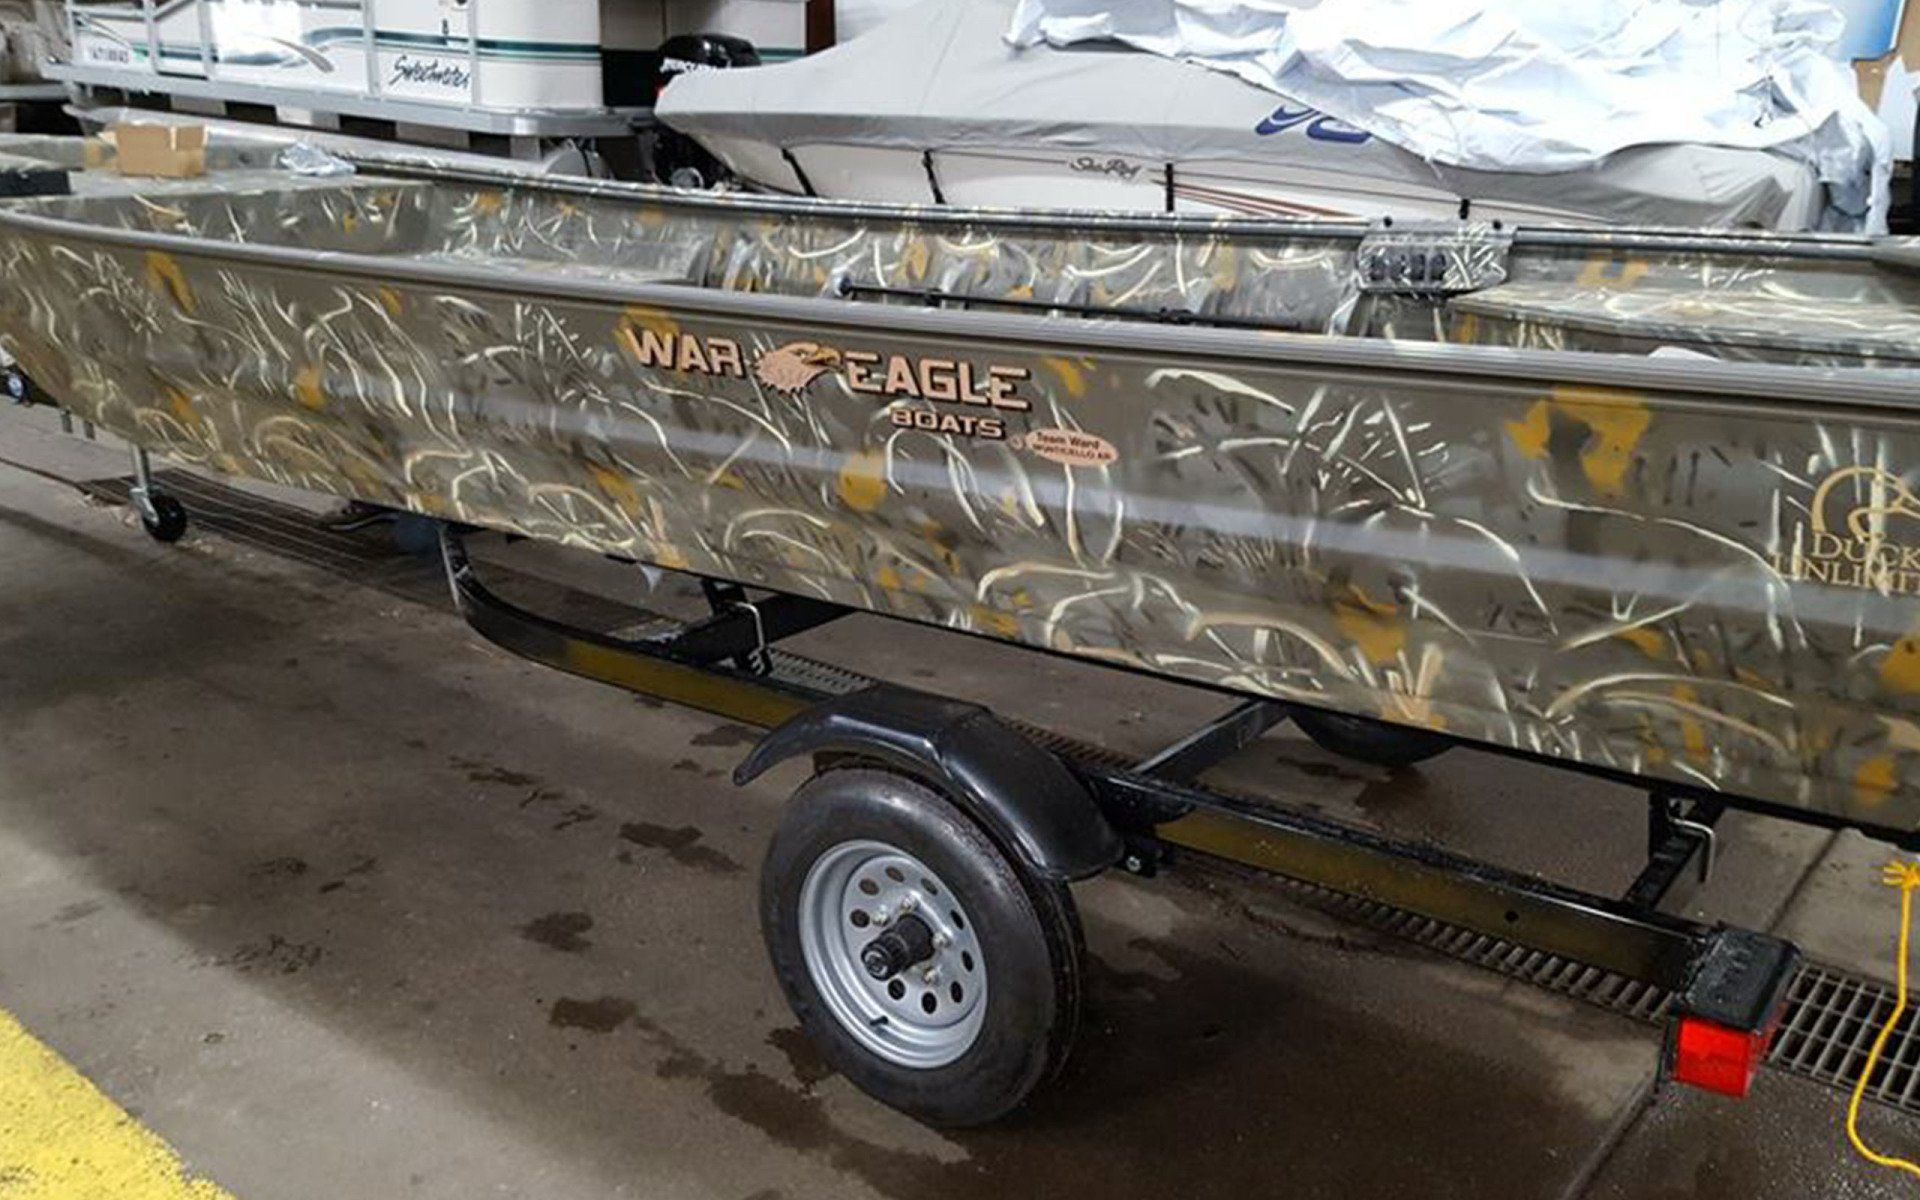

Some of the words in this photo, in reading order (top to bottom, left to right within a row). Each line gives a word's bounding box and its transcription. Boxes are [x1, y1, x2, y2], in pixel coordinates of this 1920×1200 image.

[625, 328, 746, 378] WAR
[845, 351, 1031, 411] EAGLE
[891, 407, 1005, 439] BOATS
[1037, 431, 1066, 444] Team
[1069, 435, 1099, 449] Ward
